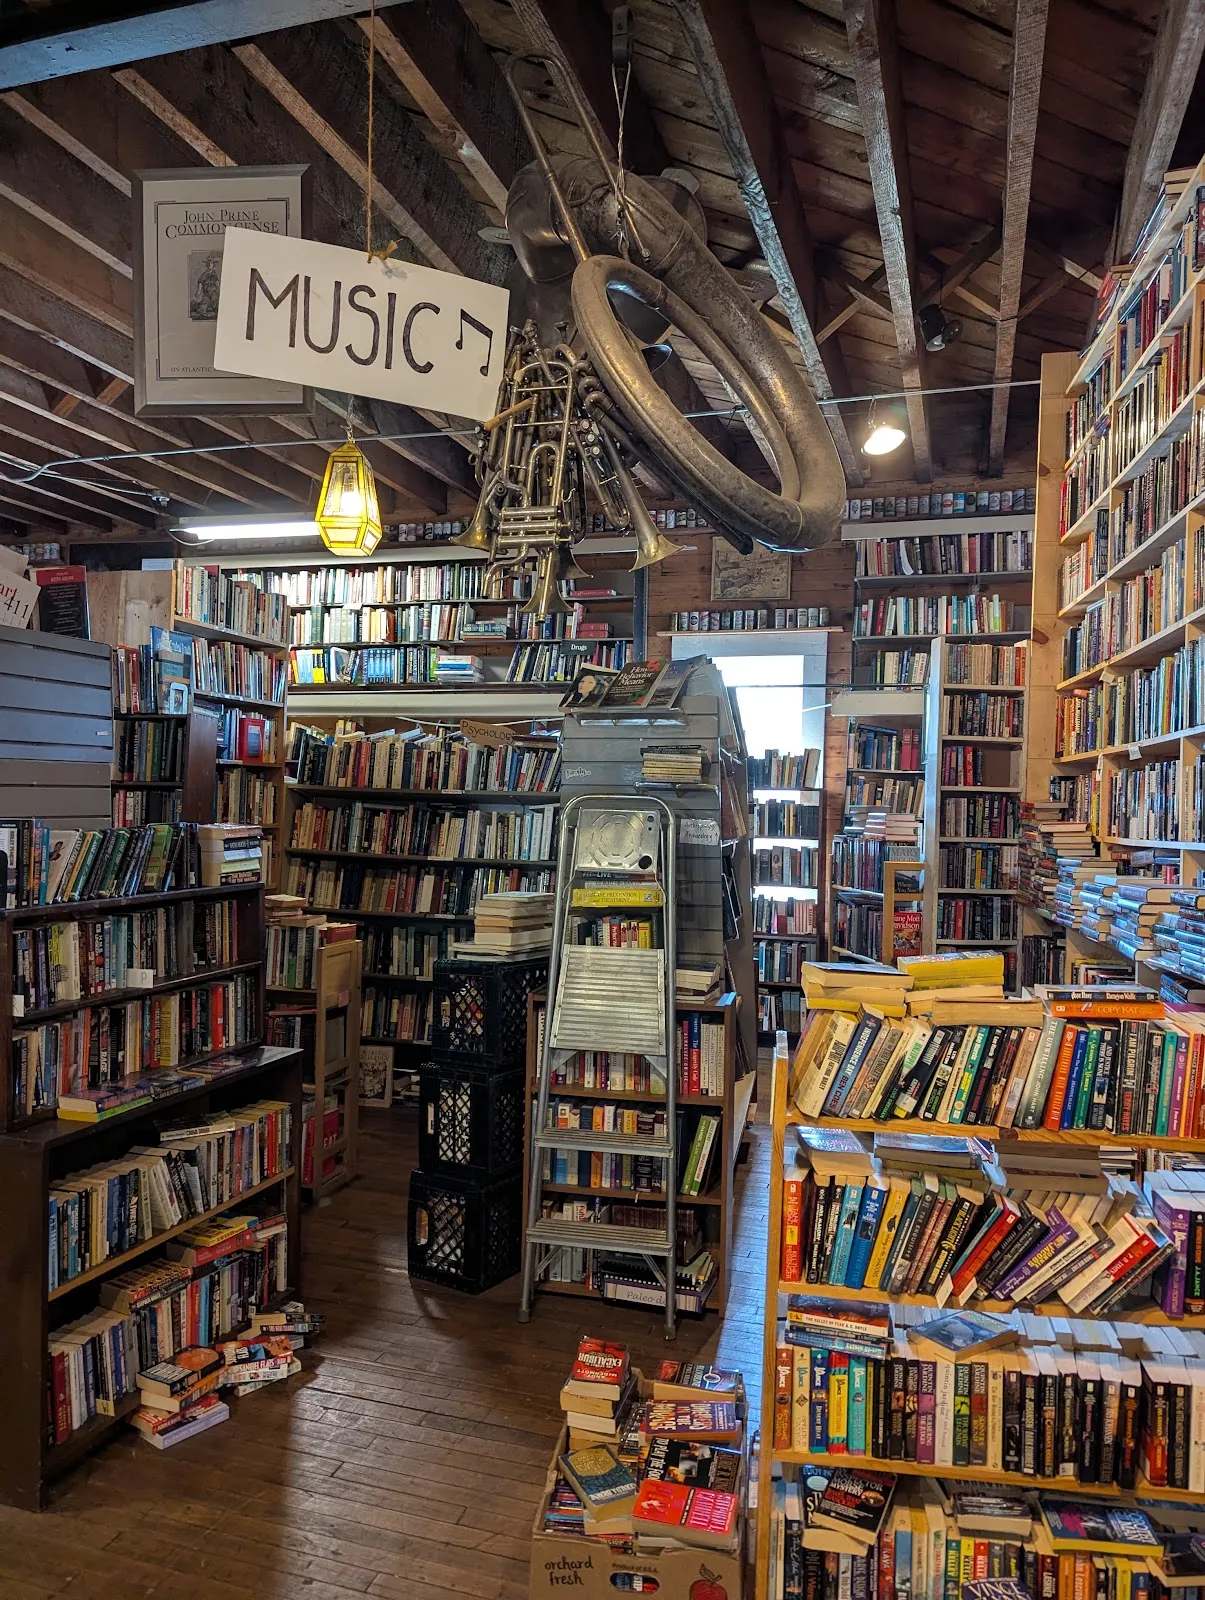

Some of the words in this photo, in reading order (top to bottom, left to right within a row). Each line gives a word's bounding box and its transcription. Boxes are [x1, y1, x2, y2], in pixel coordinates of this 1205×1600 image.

[184, 210, 214, 223] JOHN
[220, 210, 259, 222] PRINE
[246, 267, 441, 374] MUSIC
[570, 643, 587, 651] Drugs
[618, 678, 645, 686] Means
[462, 720, 513, 743] PSYCHOLOG
[1048, 1021, 1057, 1037] THE
[849, 1027, 872, 1066] INDEPENDENCE
[1129, 1037, 1137, 1047] AM
[1037, 1037, 1053, 1080] UNWILLING
[1126, 1048, 1136, 1076] PILGRIM
[845, 1065, 855, 1076] DAY
[838, 1075, 849, 1089] BEN
[1033, 1081, 1042, 1096] JOHN
[1029, 1097, 1038, 1113] HART
[952, 1209, 967, 1226] BLACK
[947, 1226, 958, 1242] LIGHT
[578, 1352, 622, 1367] EXCALIBUR
[920, 1364, 928, 1393] JARDINE
[678, 1415, 690, 1426] THE
[651, 1445, 666, 1458] PLAY
[649, 1458, 663, 1468] THE
[647, 1468, 662, 1481] FOO
[829, 1482, 864, 1496] MYSTERY
[544, 1554, 594, 1570] orchard
[947, 1551, 956, 1576] KELLEY
[963, 1555, 971, 1580] KELLEY
[549, 1571, 586, 1586] fresh
[967, 1578, 1026, 1597] VINCE
